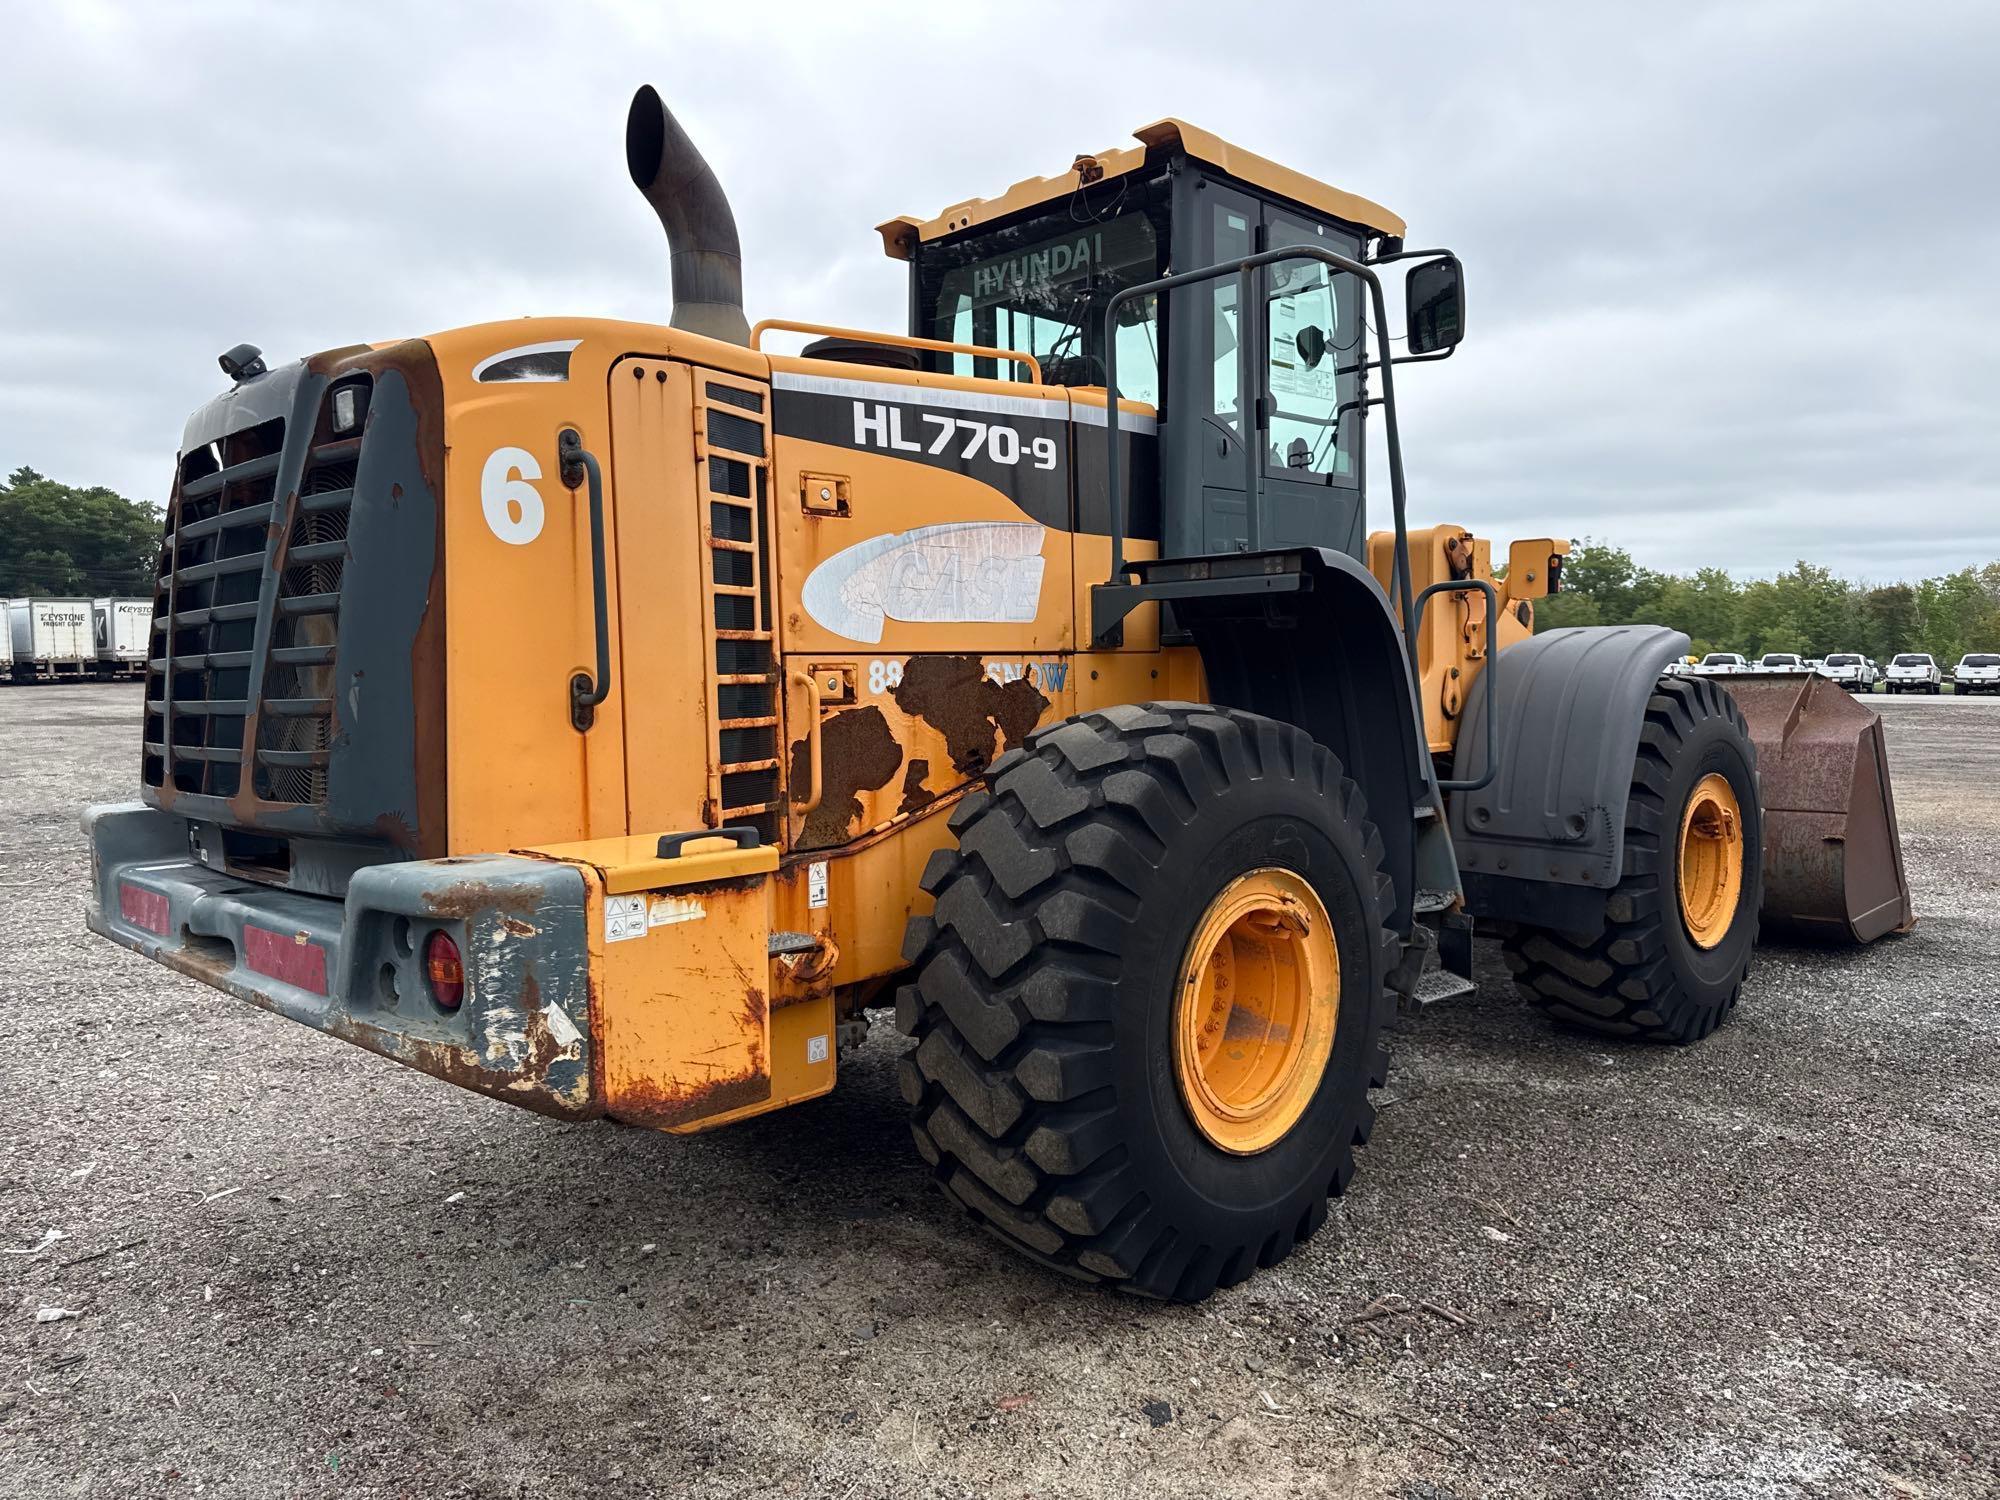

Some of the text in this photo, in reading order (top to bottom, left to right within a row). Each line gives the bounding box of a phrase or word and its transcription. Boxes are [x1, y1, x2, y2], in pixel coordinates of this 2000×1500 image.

[974, 233, 1102, 298] HYUNDAI
[481, 446, 545, 545] 6
[40, 613, 86, 622] KEYSTONE
